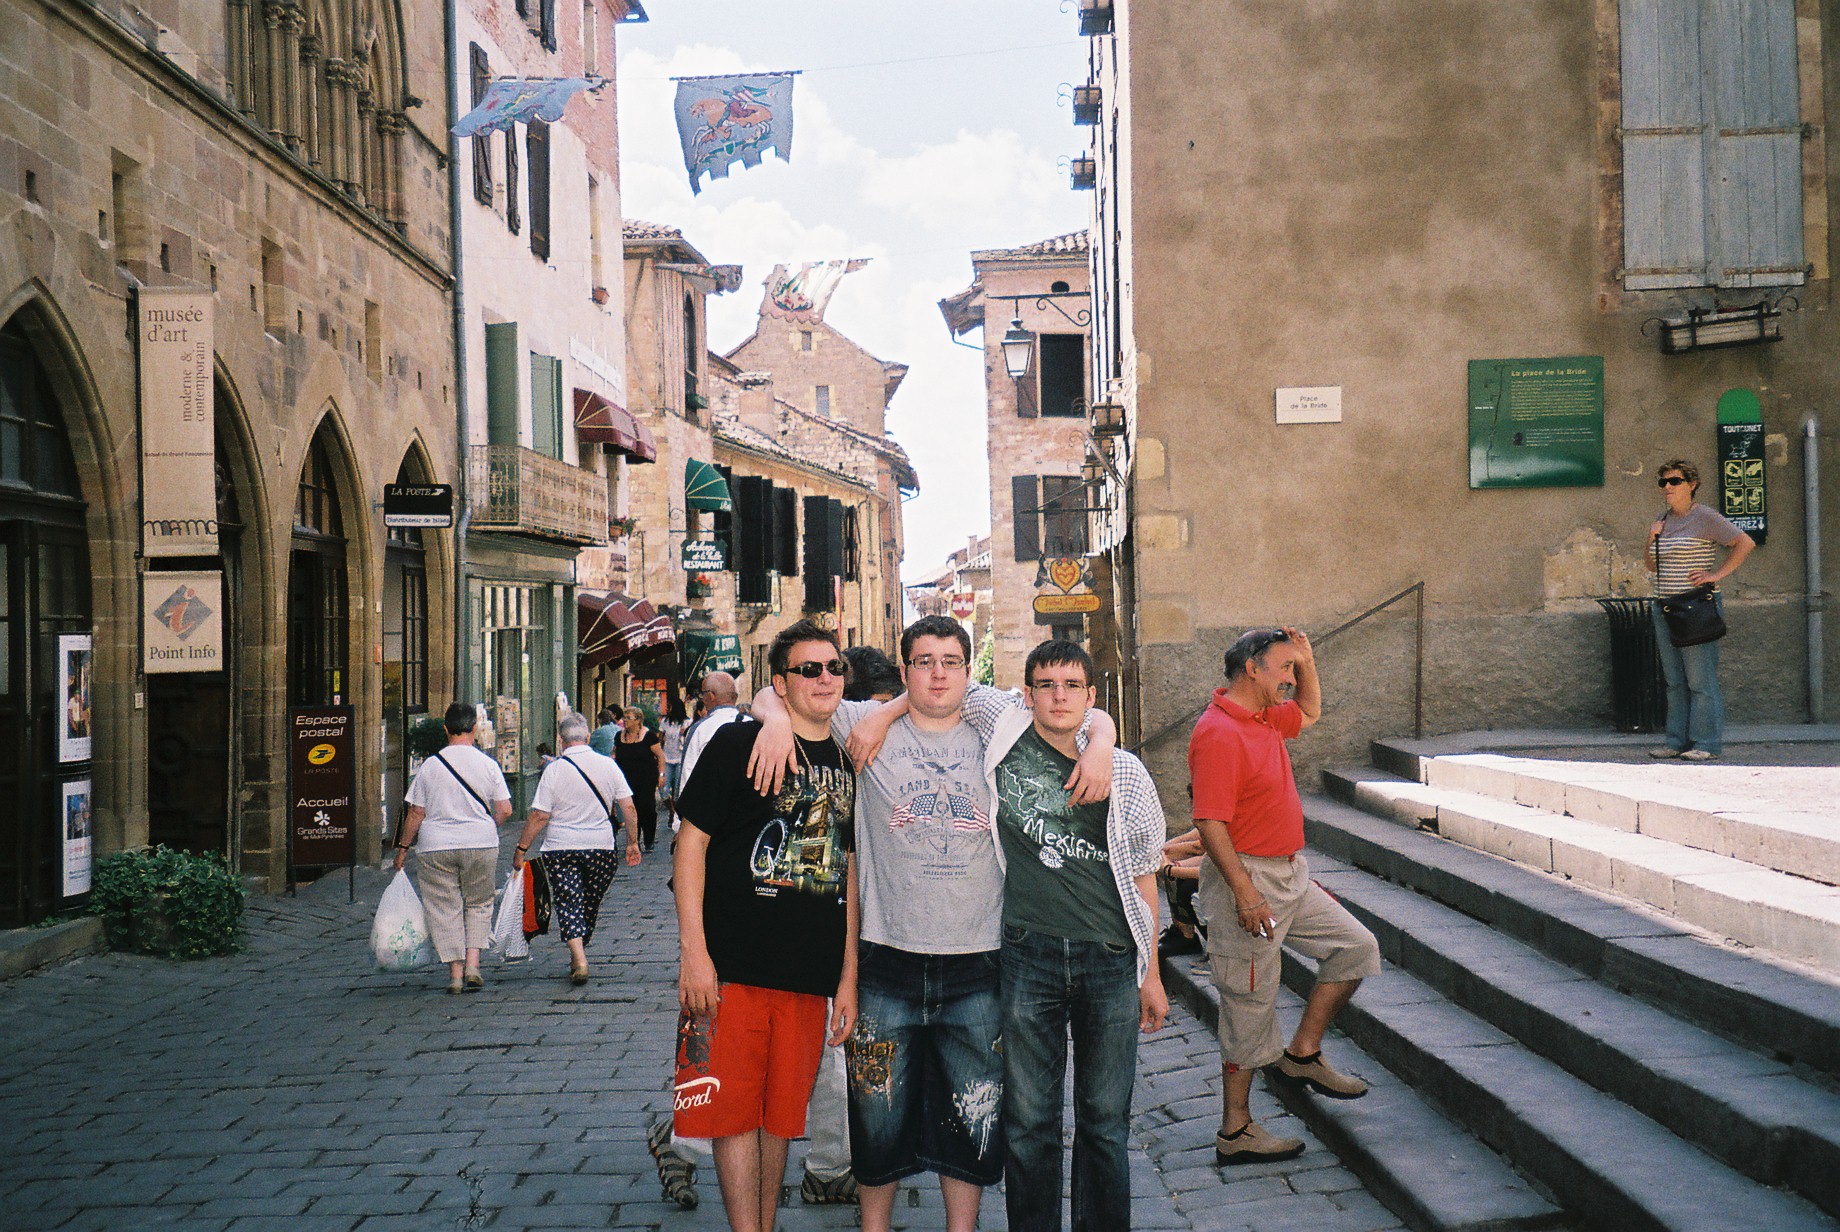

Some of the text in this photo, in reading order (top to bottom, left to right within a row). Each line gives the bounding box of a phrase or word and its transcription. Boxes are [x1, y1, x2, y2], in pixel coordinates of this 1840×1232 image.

[148, 305, 203, 322] musée
[147, 324, 188, 342] d'art
[1522, 370, 1543, 378] place
[194, 342, 208, 421] contemporain
[179, 369, 192, 421] moderne
[391, 487, 431, 496] LA POSTE
[683, 560, 725, 570] RESTAURANT
[150, 644, 216, 660] Point Info
[295, 715, 347, 727] Espace
[299, 727, 344, 739] postal
[297, 796, 349, 808] Accueil
[297, 825, 348, 836] Grands Sites
[755, 886, 779, 894] LONDON
